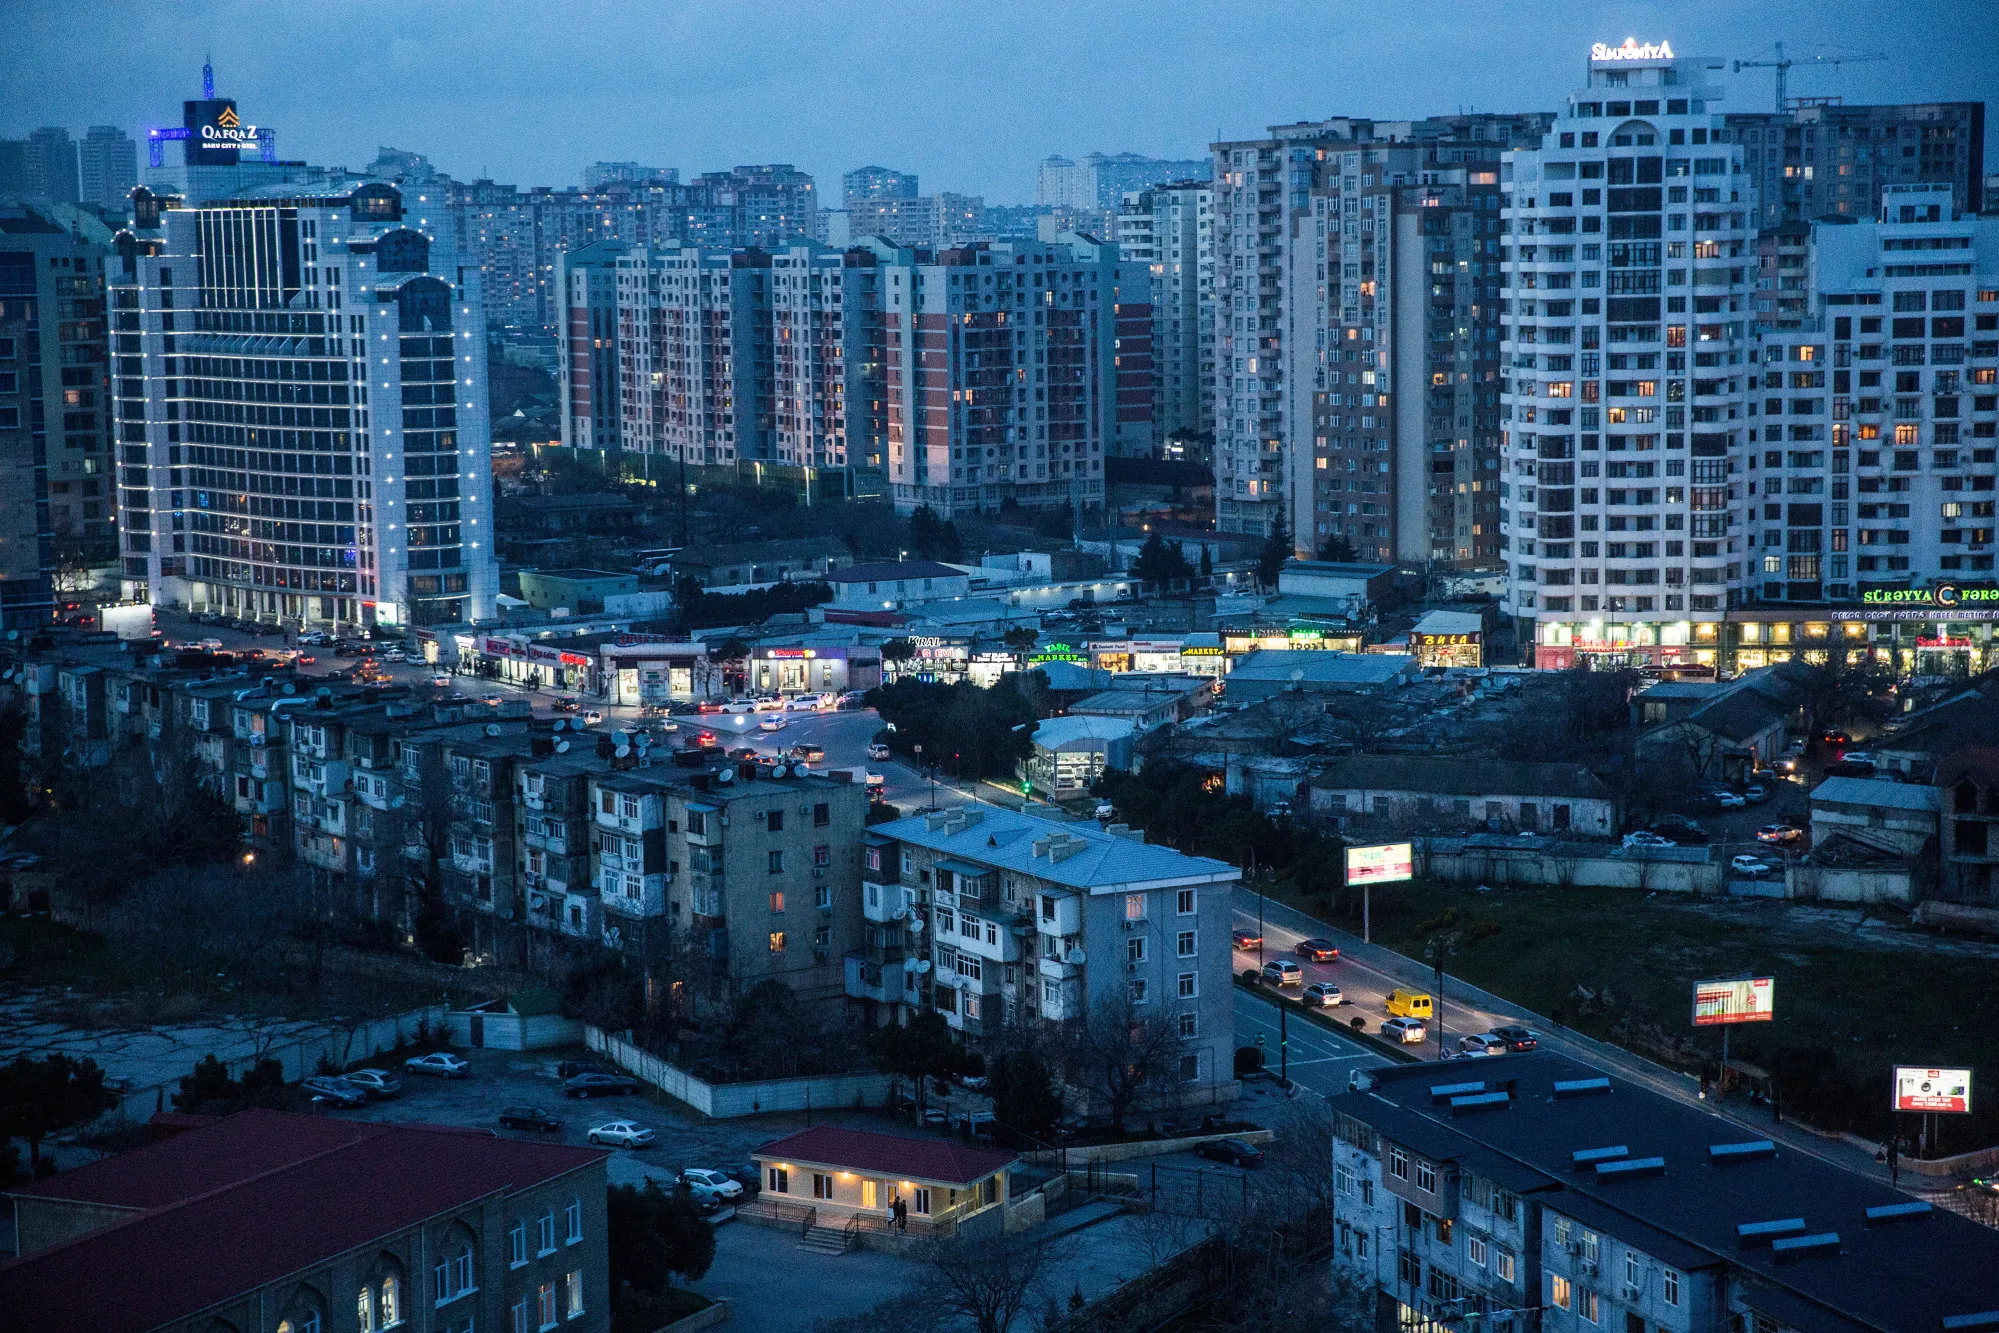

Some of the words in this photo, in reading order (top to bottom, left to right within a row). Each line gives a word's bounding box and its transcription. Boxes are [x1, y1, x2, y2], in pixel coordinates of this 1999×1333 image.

[202, 125, 257, 141] QAFQAZ
[1864, 589, 1932, 601] SÜRƏYYA
[1187, 648, 1218, 656] MARKET
